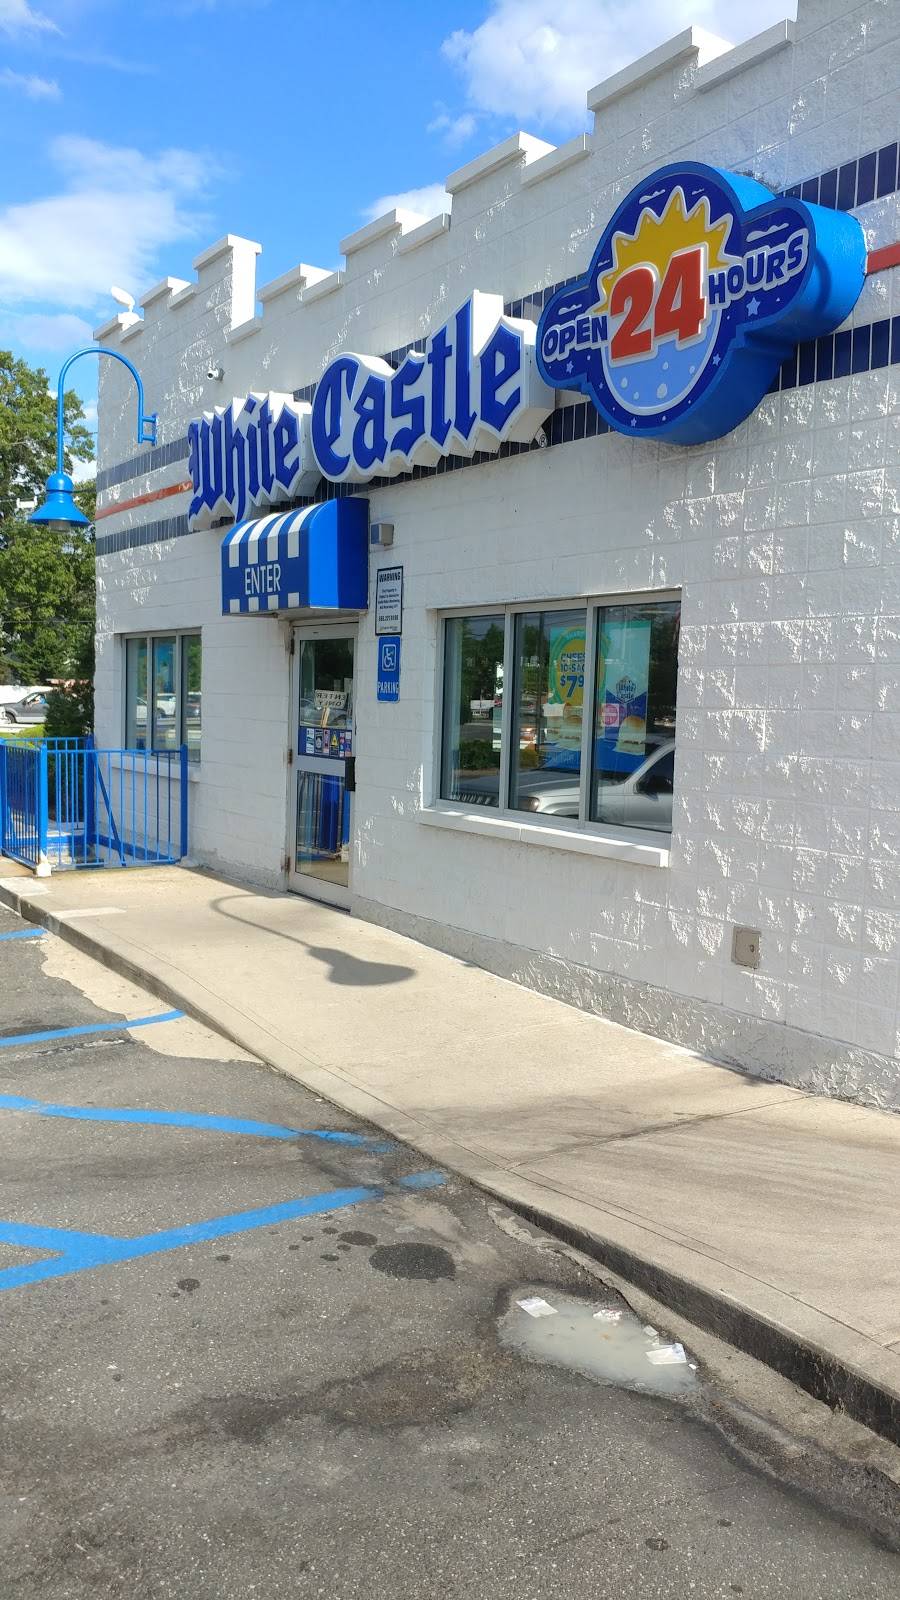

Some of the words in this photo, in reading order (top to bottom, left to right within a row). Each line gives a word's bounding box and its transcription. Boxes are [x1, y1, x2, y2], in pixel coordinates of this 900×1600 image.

[542, 314, 608, 360] OPEN
[609, 246, 706, 361] 24
[707, 233, 808, 306] HOURS
[188, 393, 301, 523] White
[311, 298, 522, 477] Castle
[244, 562, 282, 596] ENTER
[378, 571, 401, 583] WARNING
[377, 681, 399, 695] PARKING
